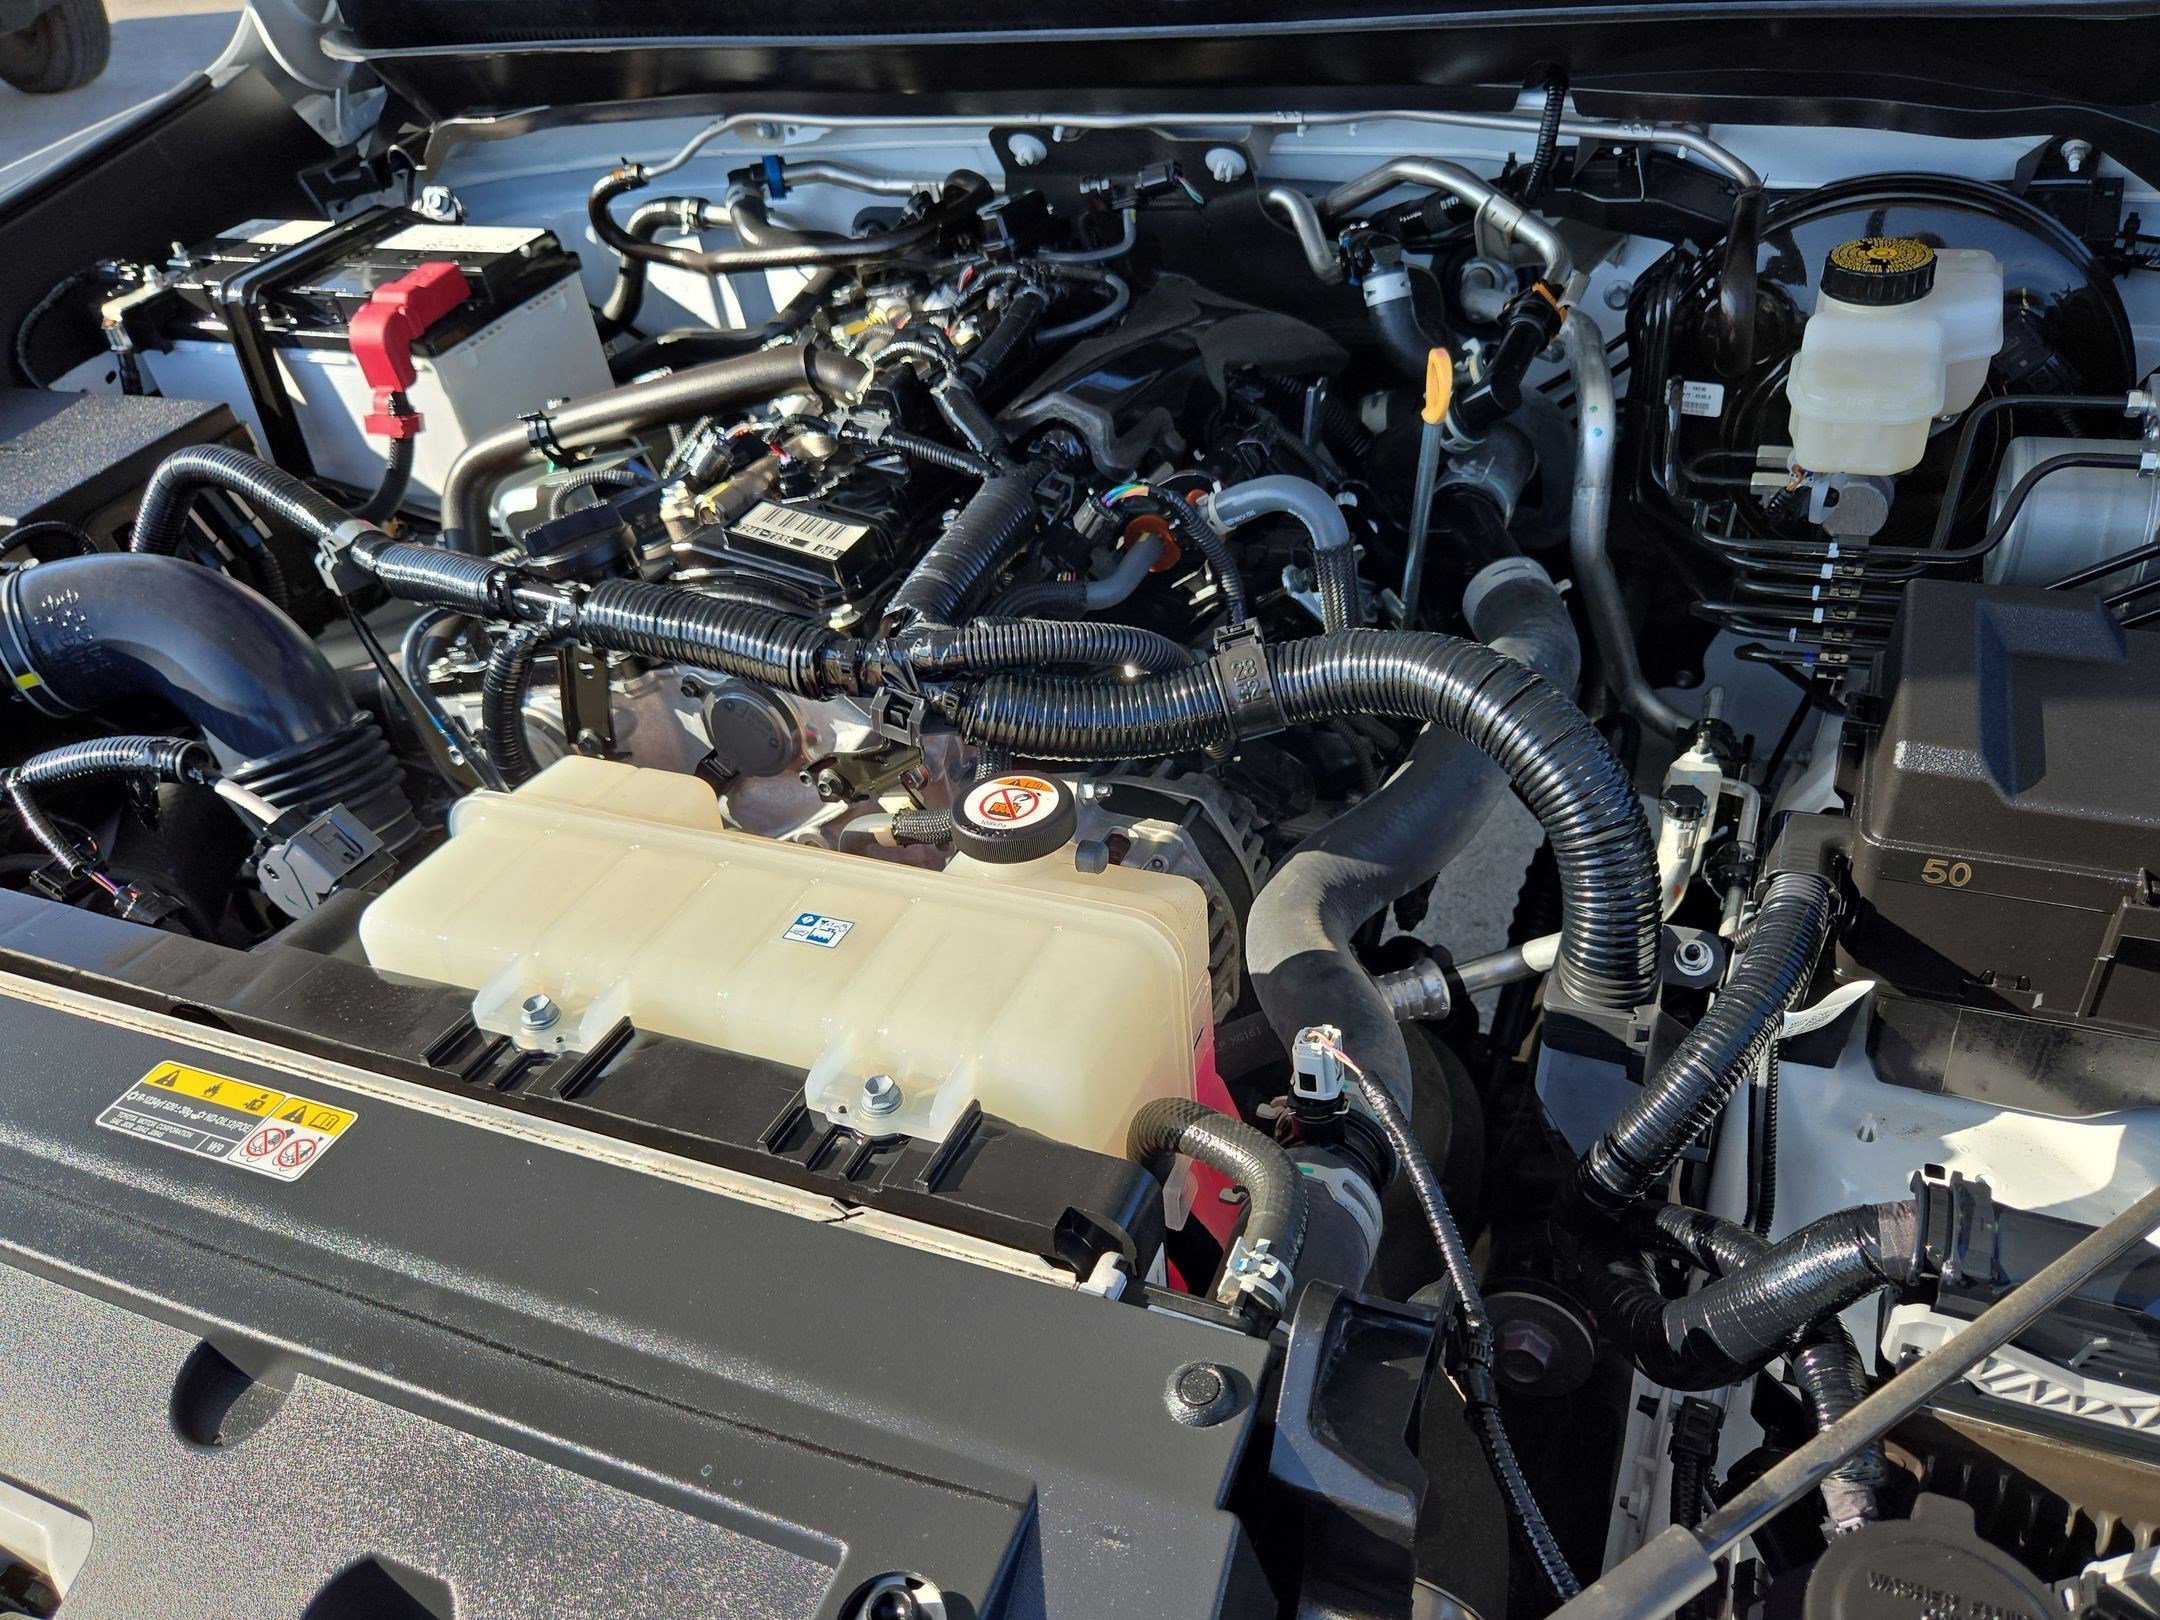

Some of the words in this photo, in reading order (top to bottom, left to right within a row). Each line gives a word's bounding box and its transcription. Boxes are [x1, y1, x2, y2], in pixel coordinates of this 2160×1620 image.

[1921, 858, 1972, 887] 50
[109, 1117, 123, 1125] SAE
[116, 1111, 138, 1121] TOYOTA
[136, 1117, 158, 1128] MOTOR
[155, 1122, 195, 1138] CORPORATION
[206, 1141, 225, 1153] W9
